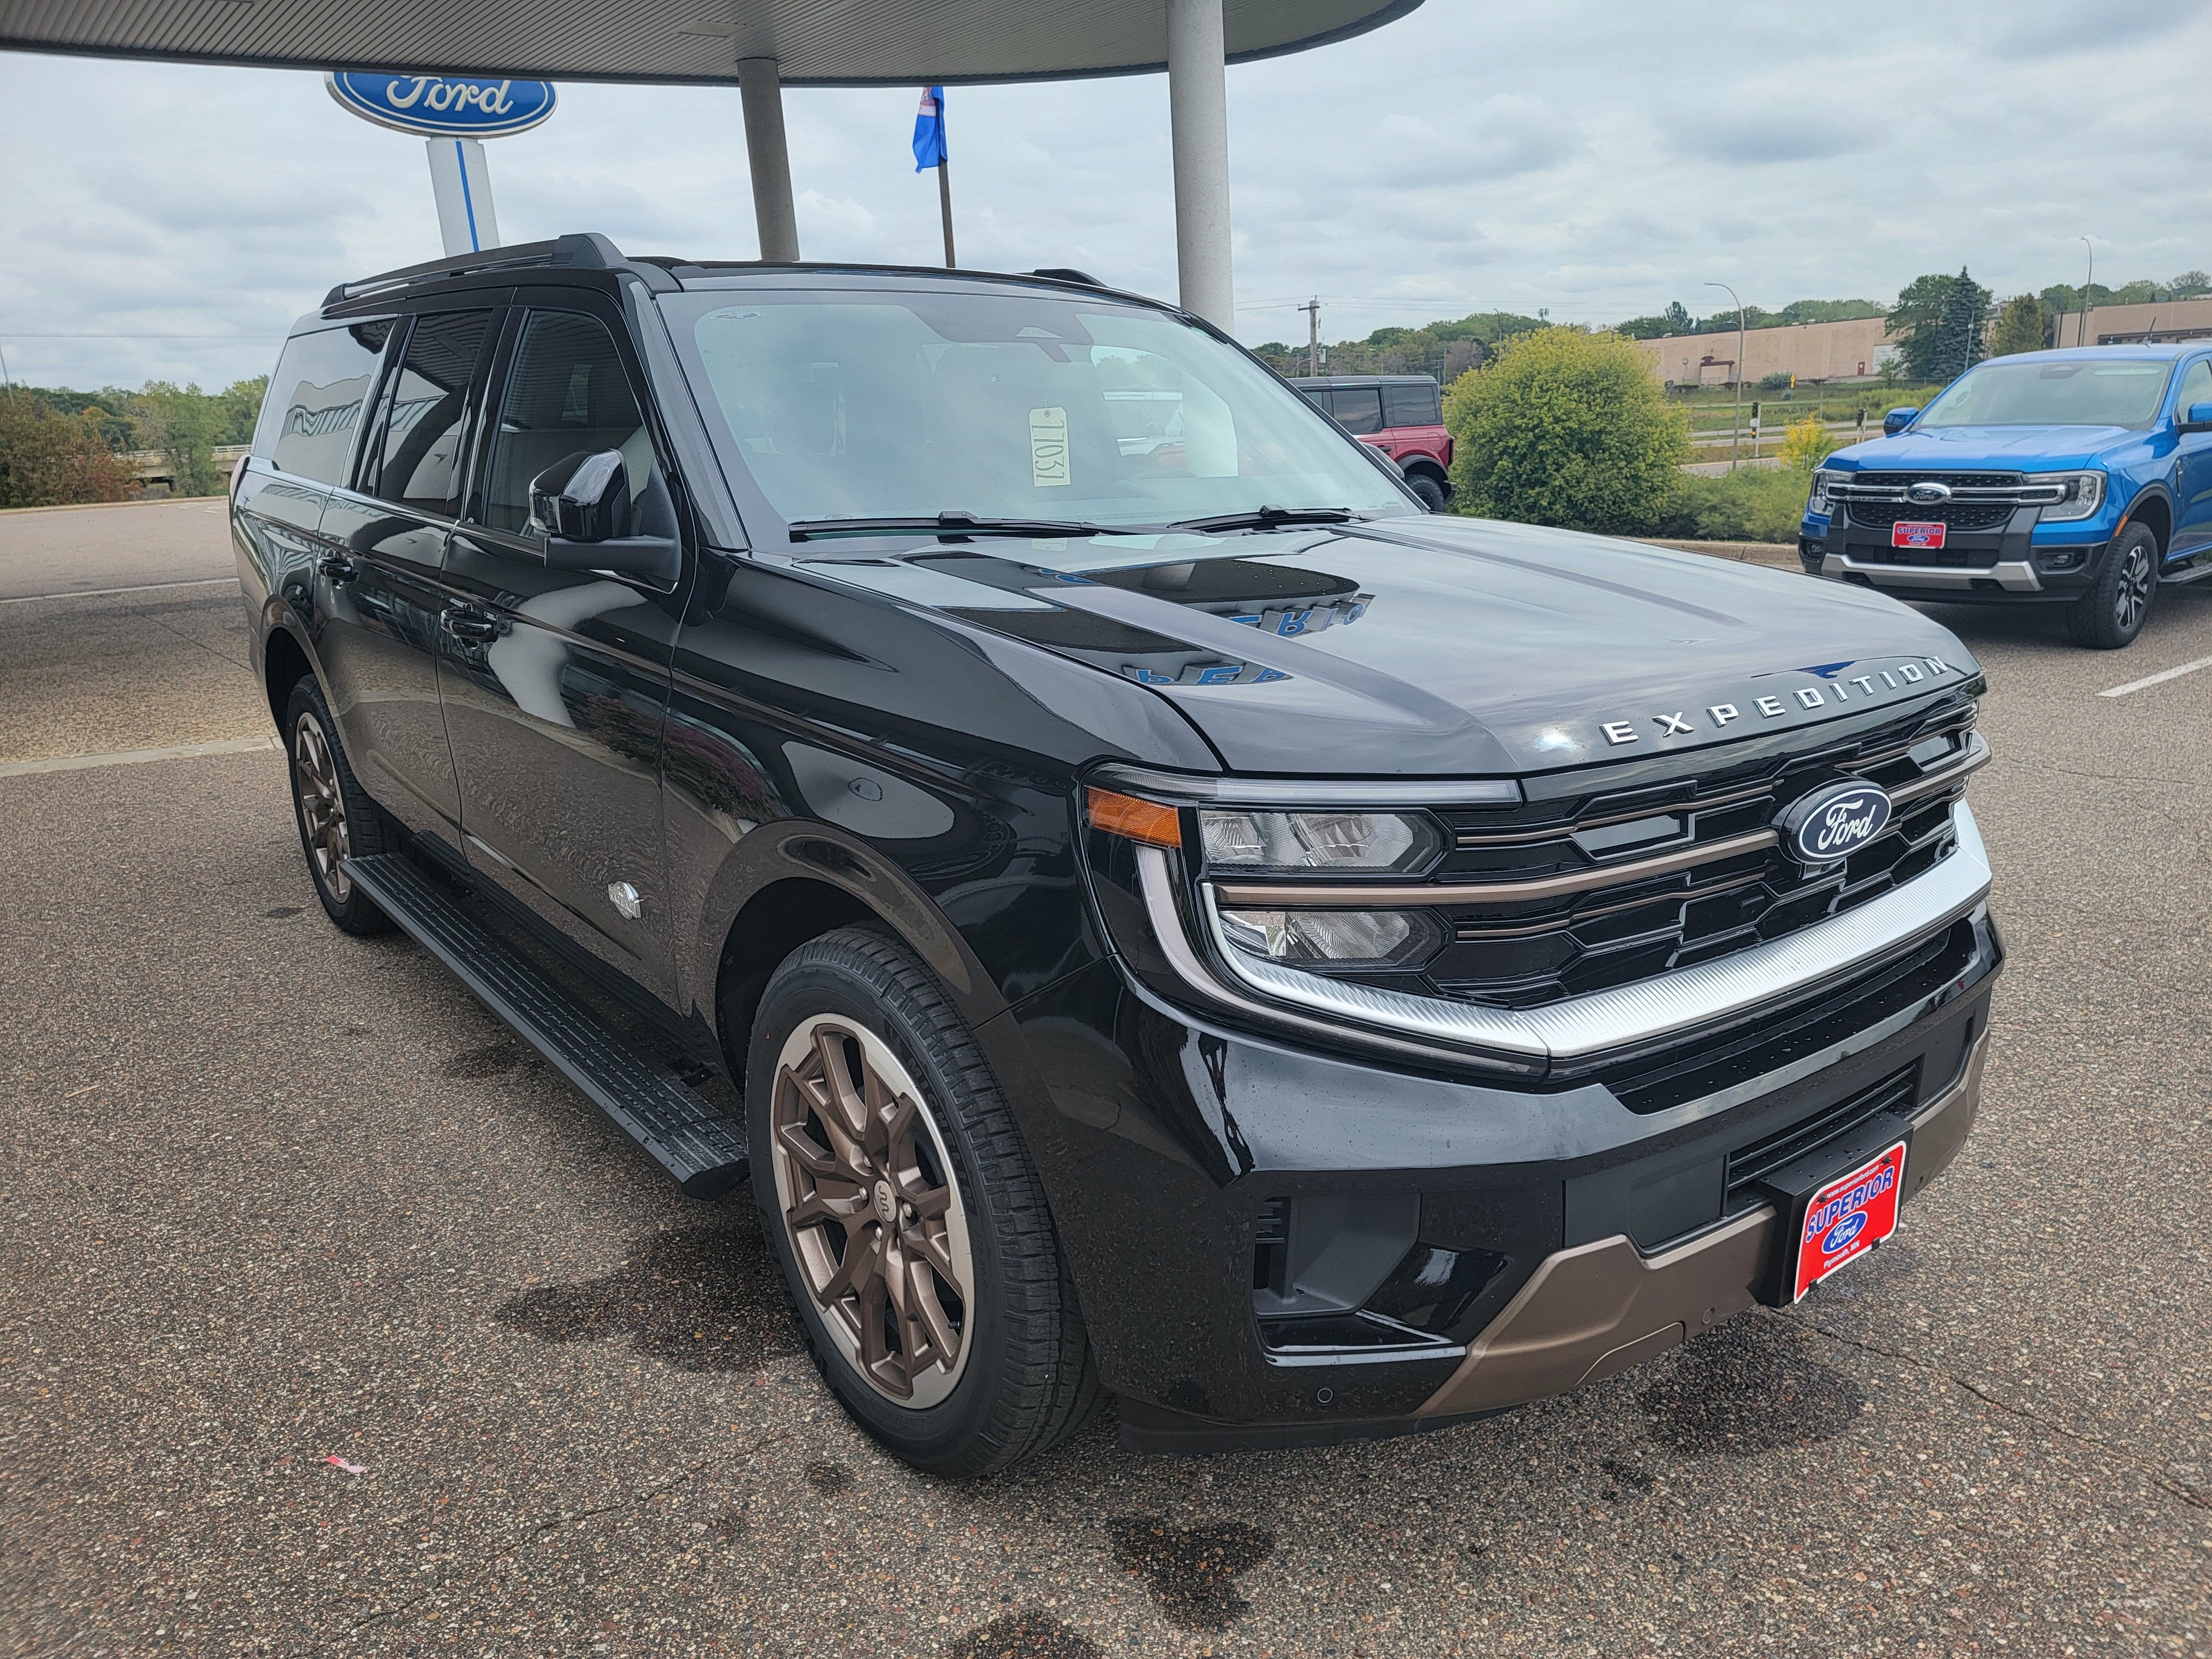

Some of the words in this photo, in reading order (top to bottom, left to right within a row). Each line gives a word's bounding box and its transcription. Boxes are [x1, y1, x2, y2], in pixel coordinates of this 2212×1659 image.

[387, 75, 514, 115] Ford
[1913, 491, 1936, 500] Ford
[1599, 656, 1949, 746] EXPEDITION
[1818, 799, 1877, 851] Ford
[906, 1056, 978, 1213] MICHELIN
[1806, 1166, 1895, 1243] SUPERIOR
[1829, 1218, 1860, 1249] Ford
[1850, 1240, 1860, 1251] MN
